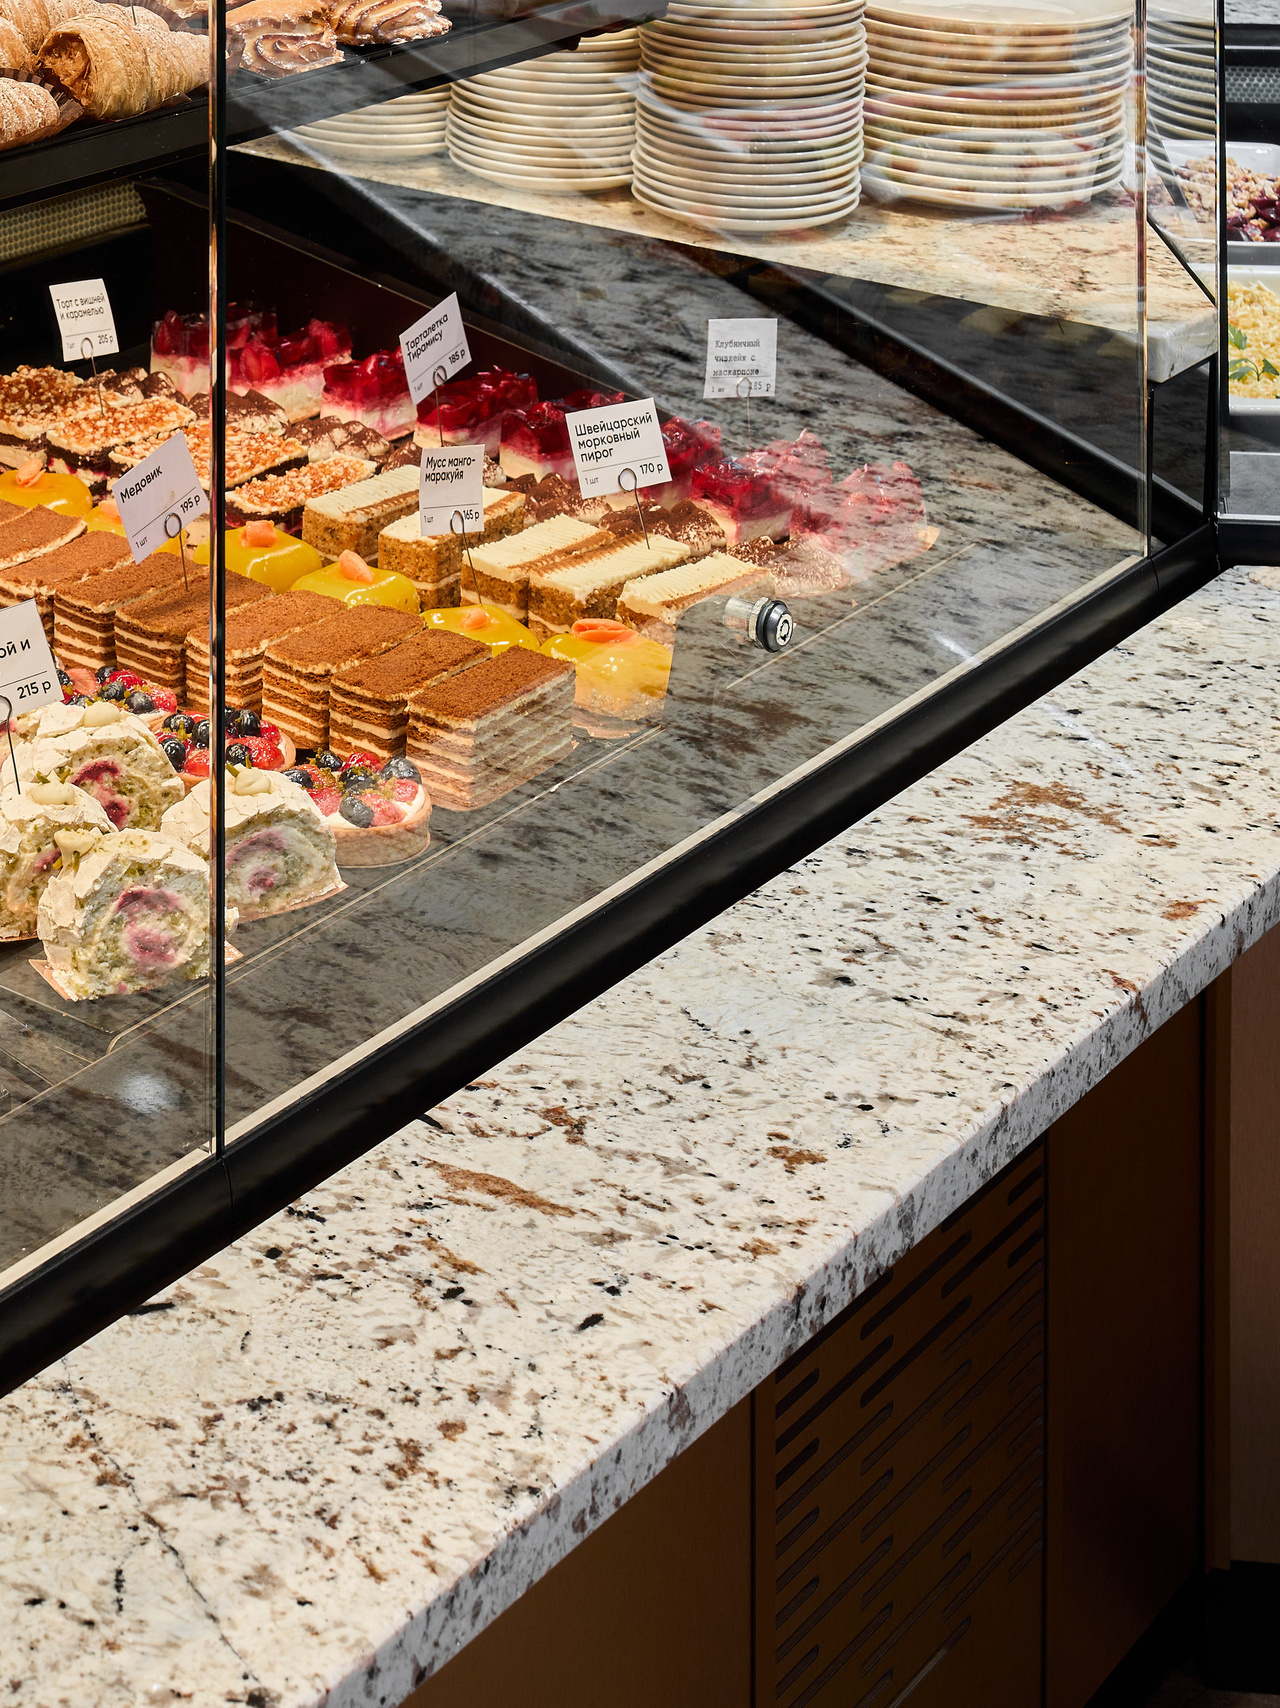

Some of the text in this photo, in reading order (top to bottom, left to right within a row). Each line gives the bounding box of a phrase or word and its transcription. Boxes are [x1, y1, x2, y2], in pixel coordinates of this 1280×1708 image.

[56, 298, 72, 310] Торт
[80, 293, 106, 306] вишней
[66, 306, 104, 320] карамелью
[406, 314, 448, 351] Тарталетка
[109, 336, 114, 345] р
[407, 330, 443, 362] Тирамису
[715, 339, 760, 349] Клубничный
[448, 349, 465, 364] 185 р
[714, 354, 746, 362] чизкейк
[713, 368, 760, 377] маскарпоне
[574, 412, 652, 436] Швейцарский
[578, 428, 640, 450] морковный
[580, 448, 614, 462] пирог
[426, 457, 476, 471] Мусс манго-
[640, 463, 663, 474] 170 р
[425, 468, 464, 484] маракуйя
[120, 466, 163, 503] Медовик
[180, 494, 200, 513] 195 р
[463, 509, 479, 521] 165 р
[140, 536, 148, 546] шт
[20, 639, 31, 651] и
[17, 680, 51, 699] 215 р
